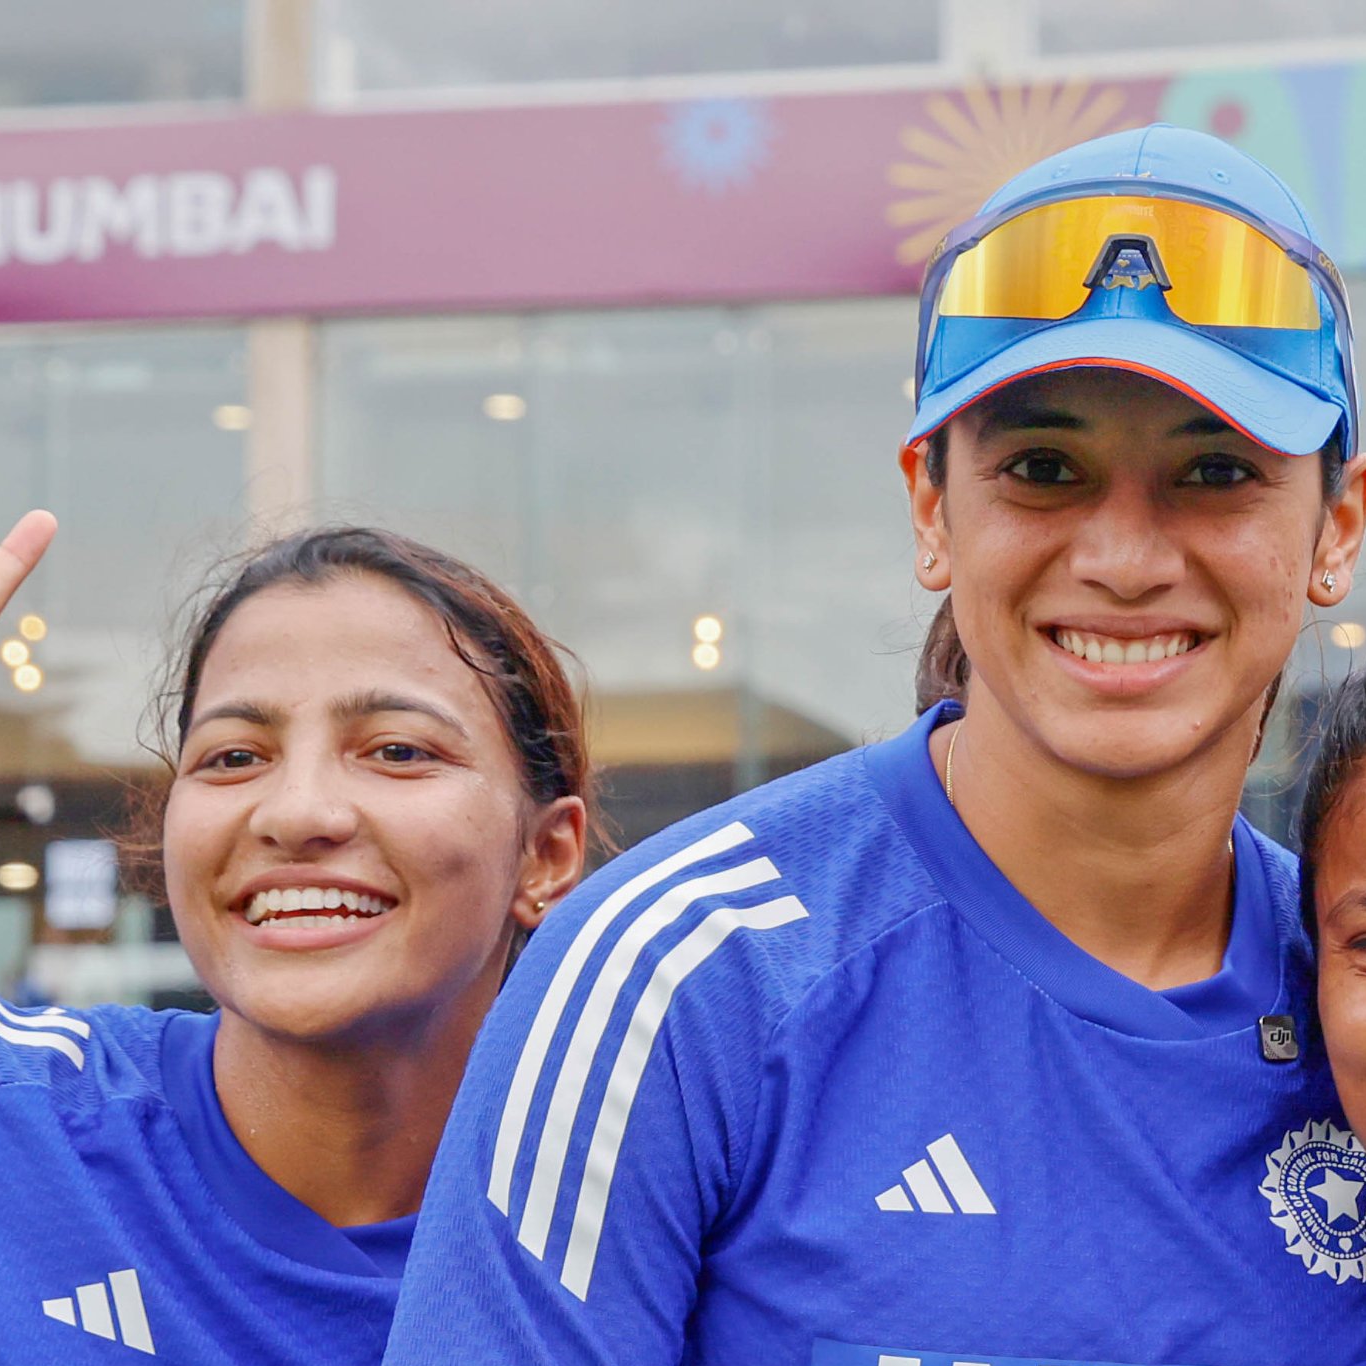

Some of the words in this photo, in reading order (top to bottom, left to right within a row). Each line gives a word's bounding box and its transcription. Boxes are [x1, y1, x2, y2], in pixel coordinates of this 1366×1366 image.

[1269, 1027, 1291, 1046] dji
[1316, 1150, 1339, 1163] FOR
[1286, 1152, 1316, 1192] CONTROL
[1289, 1194, 1304, 1208] OF
[1300, 1209, 1330, 1246] BOARD
